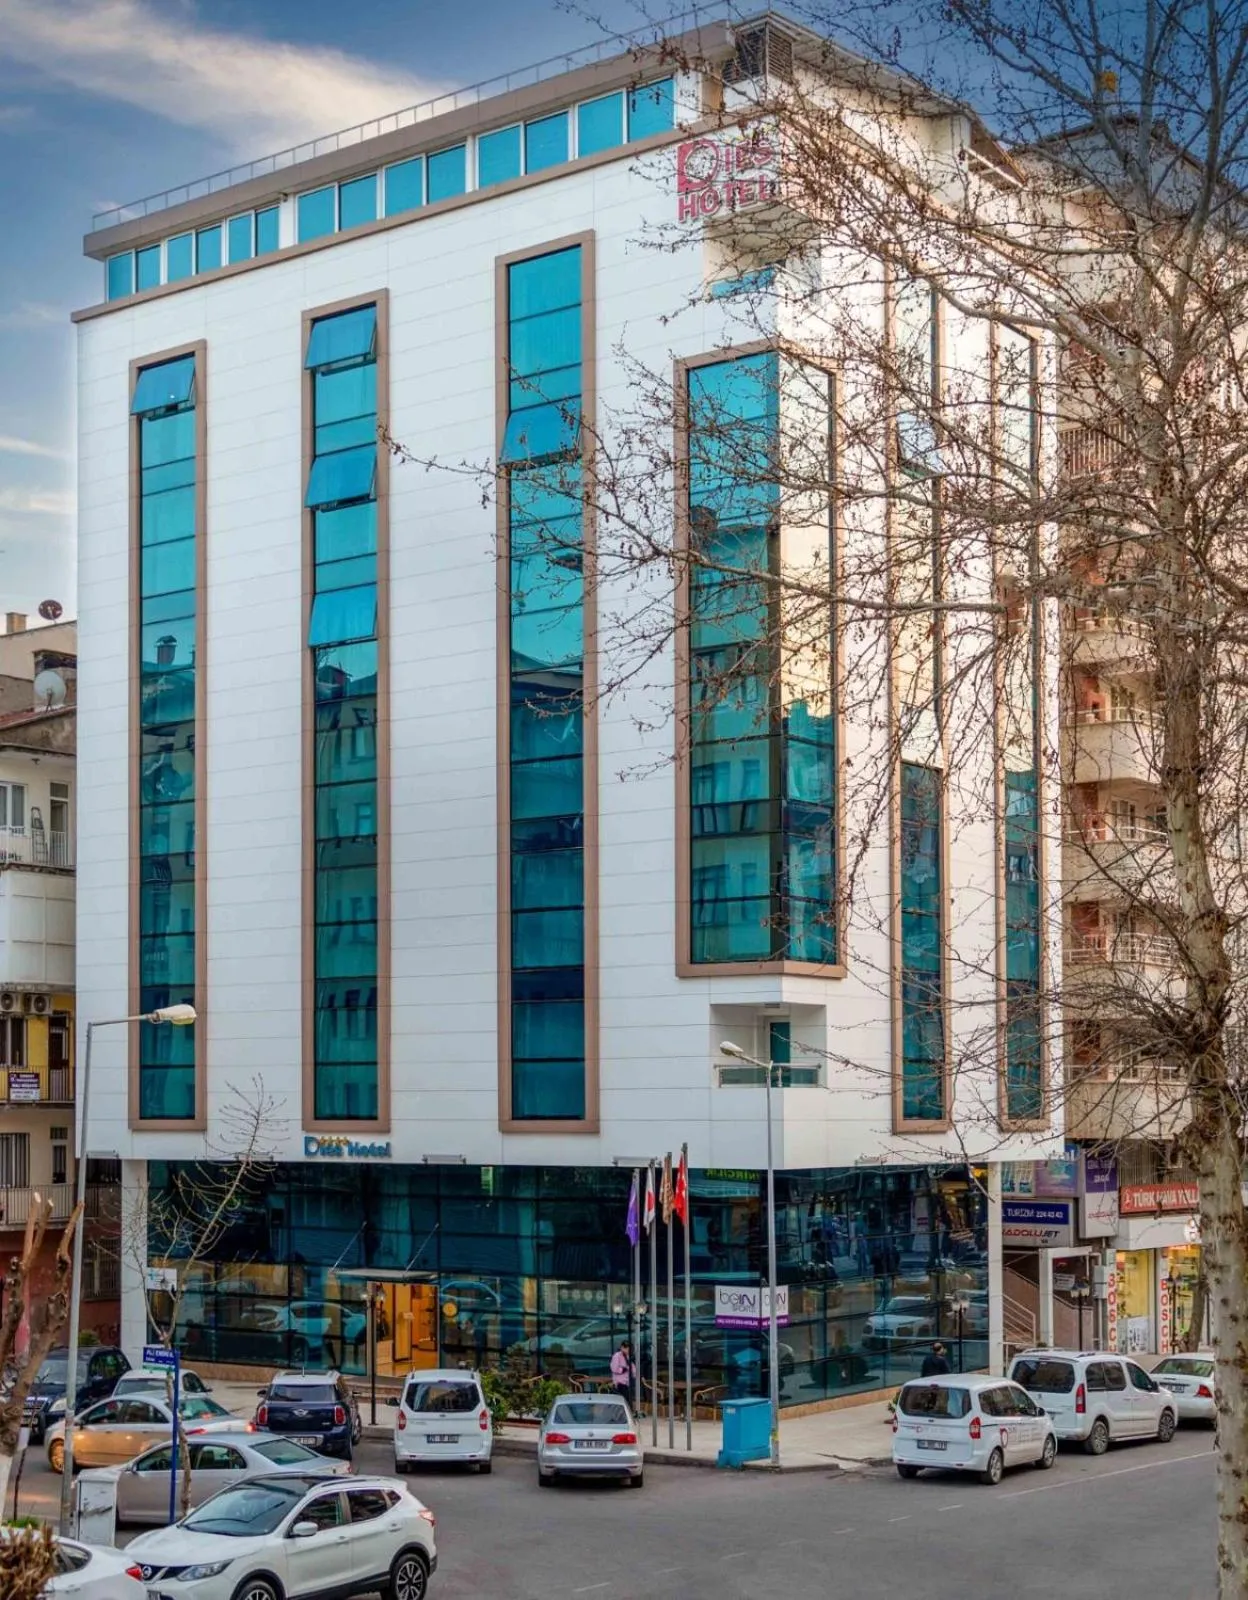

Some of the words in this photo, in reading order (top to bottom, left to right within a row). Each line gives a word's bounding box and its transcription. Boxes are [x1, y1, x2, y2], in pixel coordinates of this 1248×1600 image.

[677, 175, 775, 223] HOTEL
[347, 1141, 391, 1158] Hotel
[1134, 1189, 1154, 1208] TÜRK
[1160, 1280, 1168, 1353] BOSCH
